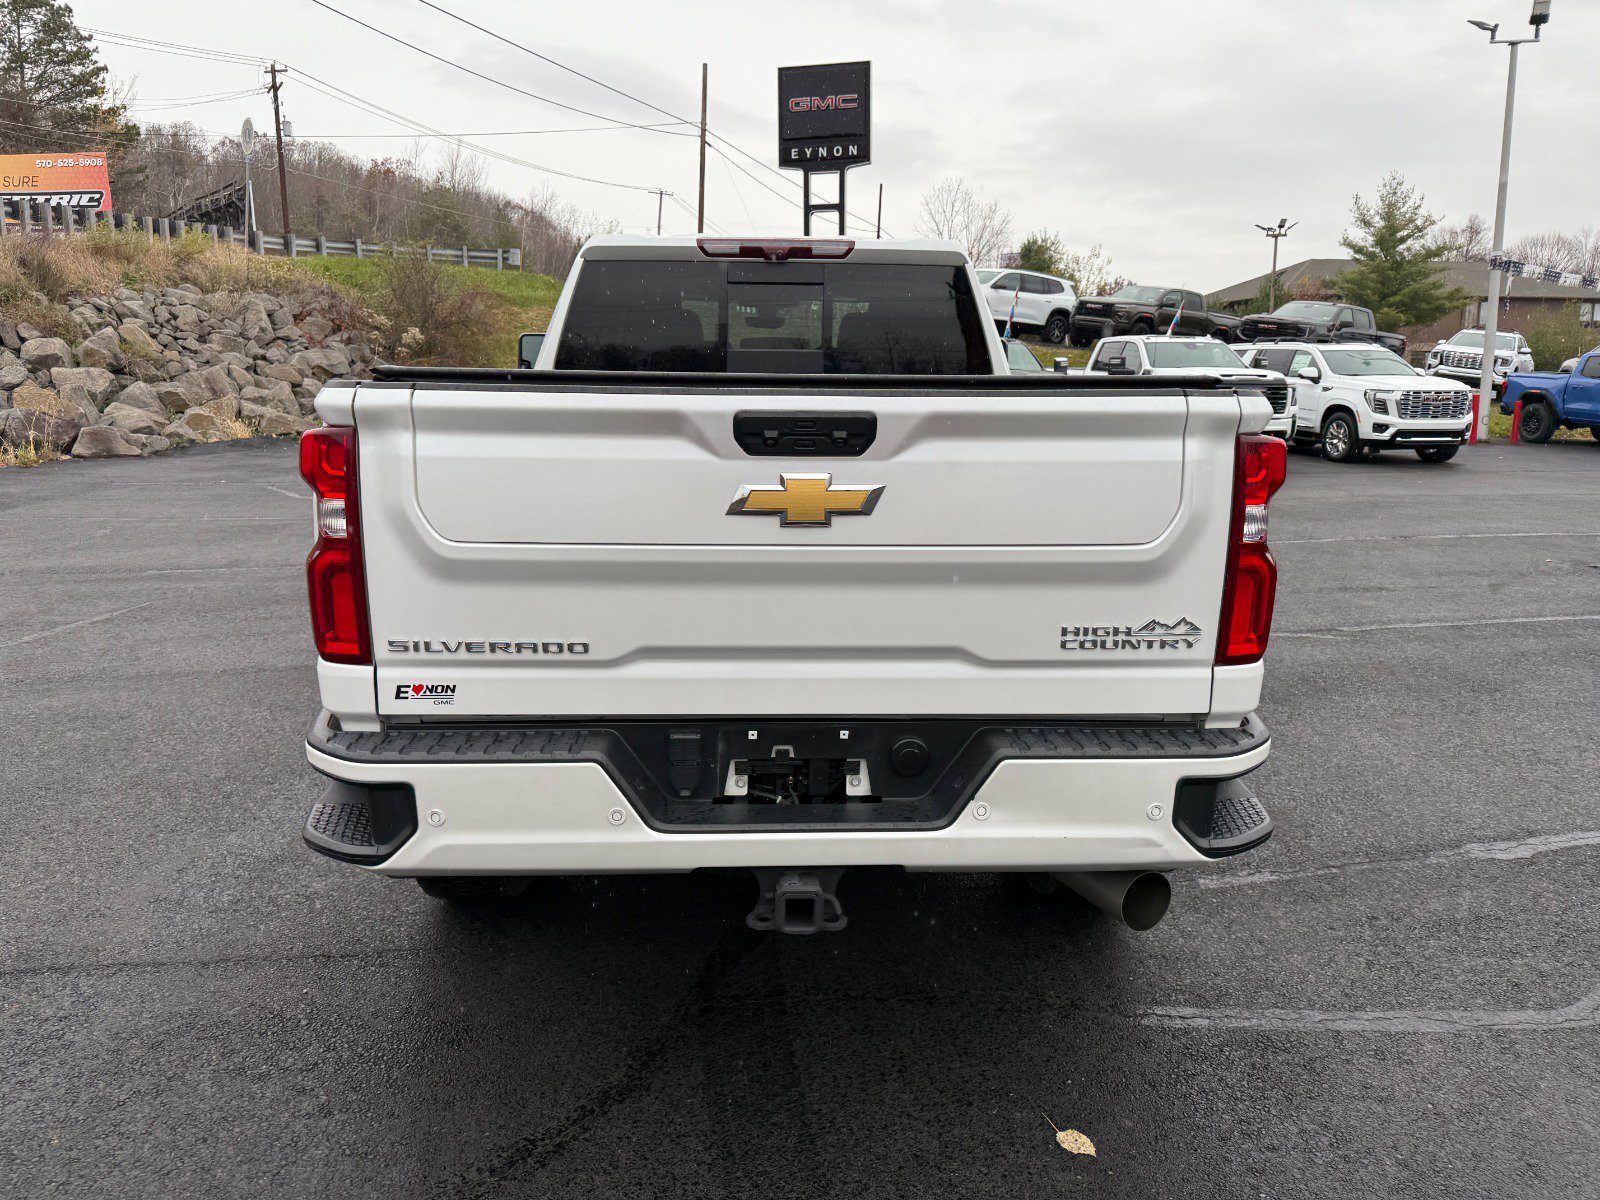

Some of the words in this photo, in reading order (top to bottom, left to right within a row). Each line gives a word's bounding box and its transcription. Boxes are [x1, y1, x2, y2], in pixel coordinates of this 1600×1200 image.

[789, 94, 858, 112] GMC
[791, 145, 858, 159] EYNON
[2, 175, 39, 188] SURE
[1061, 625, 1133, 637] HIGH
[387, 639, 590, 654] SILVERADO
[1060, 637, 1201, 650] COUNTRY
